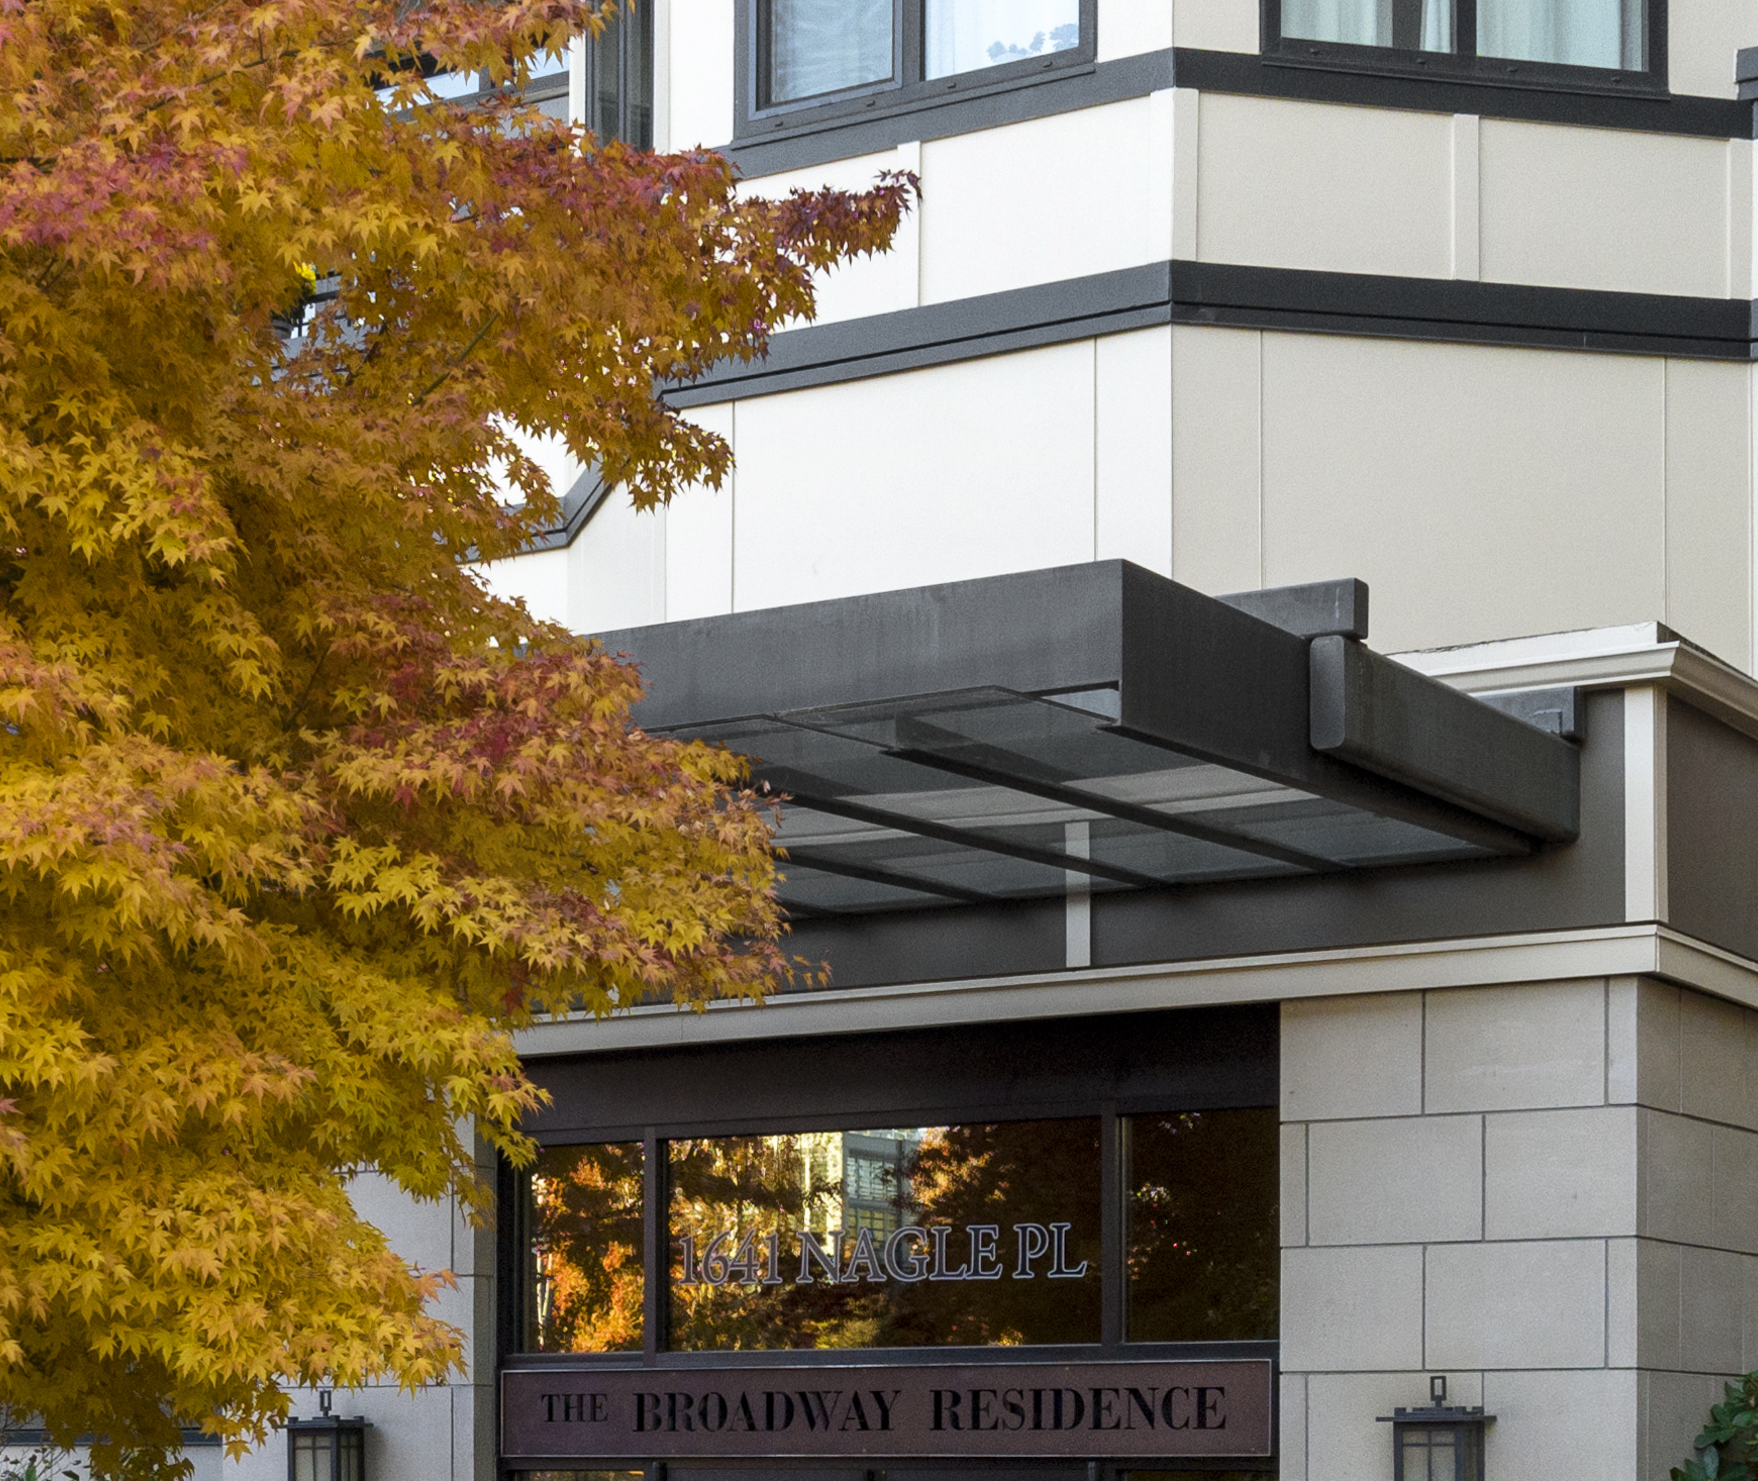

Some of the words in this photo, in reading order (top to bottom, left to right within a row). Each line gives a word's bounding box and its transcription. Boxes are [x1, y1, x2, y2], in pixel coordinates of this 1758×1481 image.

[678, 1227, 783, 1286] 1641
[796, 1224, 1004, 1283] NAGLE
[1012, 1222, 1087, 1279] PL
[541, 1392, 609, 1423] THE
[632, 1389, 902, 1433] BROADWAY
[928, 1386, 1228, 1432] RESIDENCE
